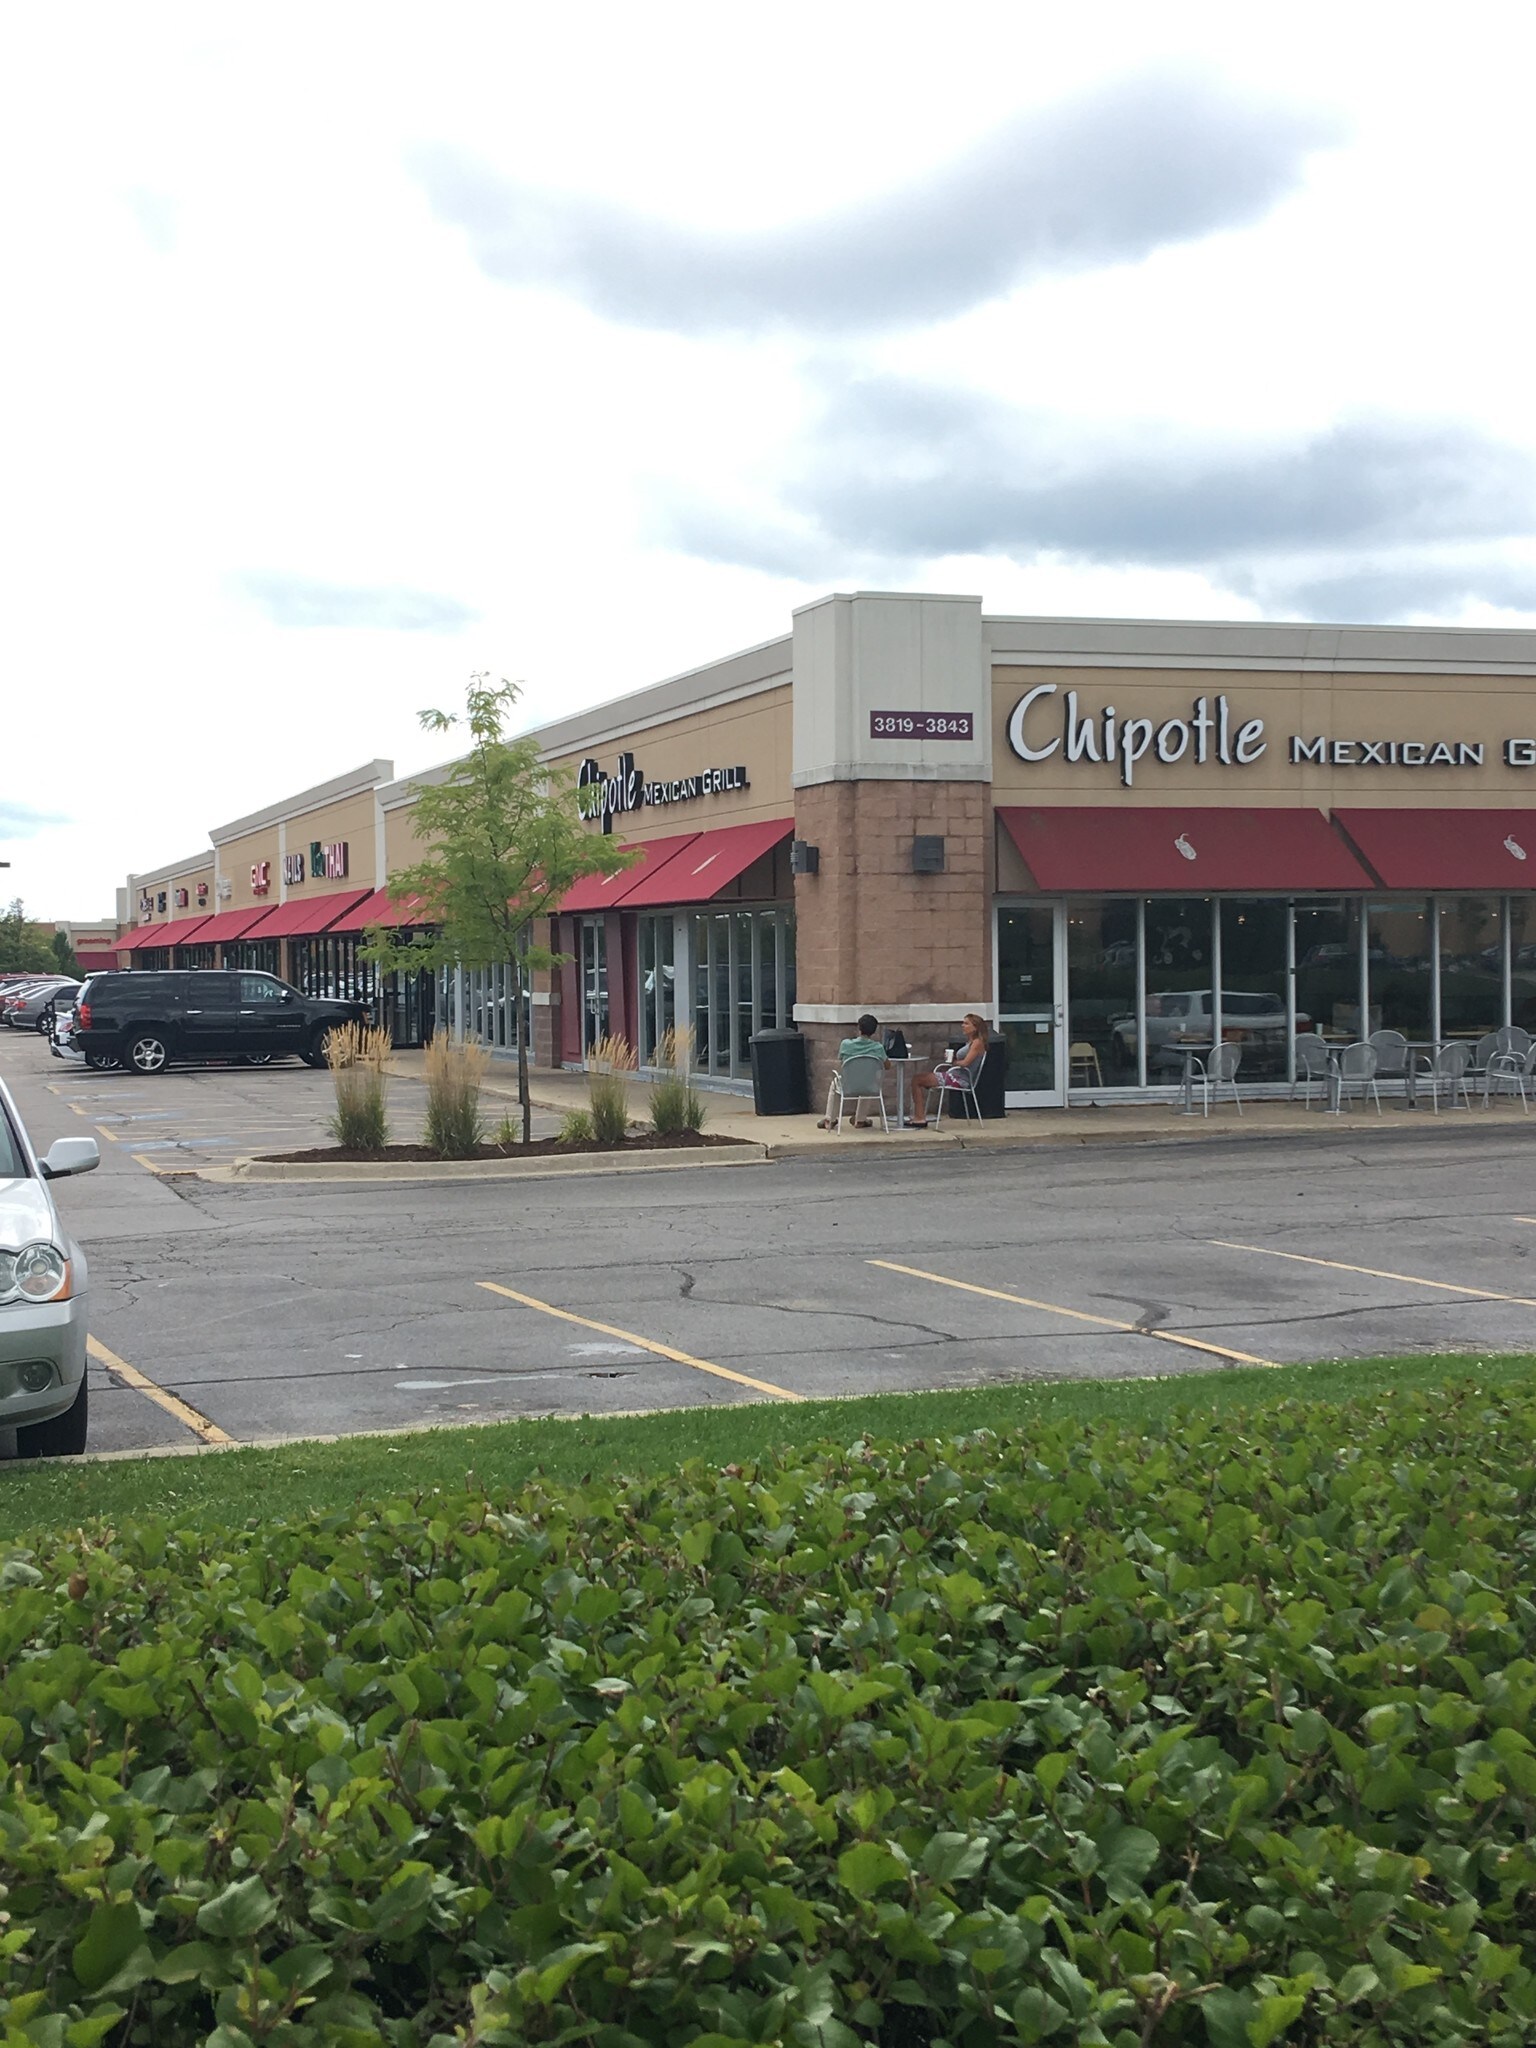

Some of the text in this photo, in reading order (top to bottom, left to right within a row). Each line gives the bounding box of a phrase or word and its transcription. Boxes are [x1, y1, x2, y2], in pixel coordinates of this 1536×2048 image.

[1008, 683, 1267, 786] Chipotle
[1290, 735, 1484, 766] MEXICAN
[577, 752, 748, 835] Chipotle MEXICAN GRILL
